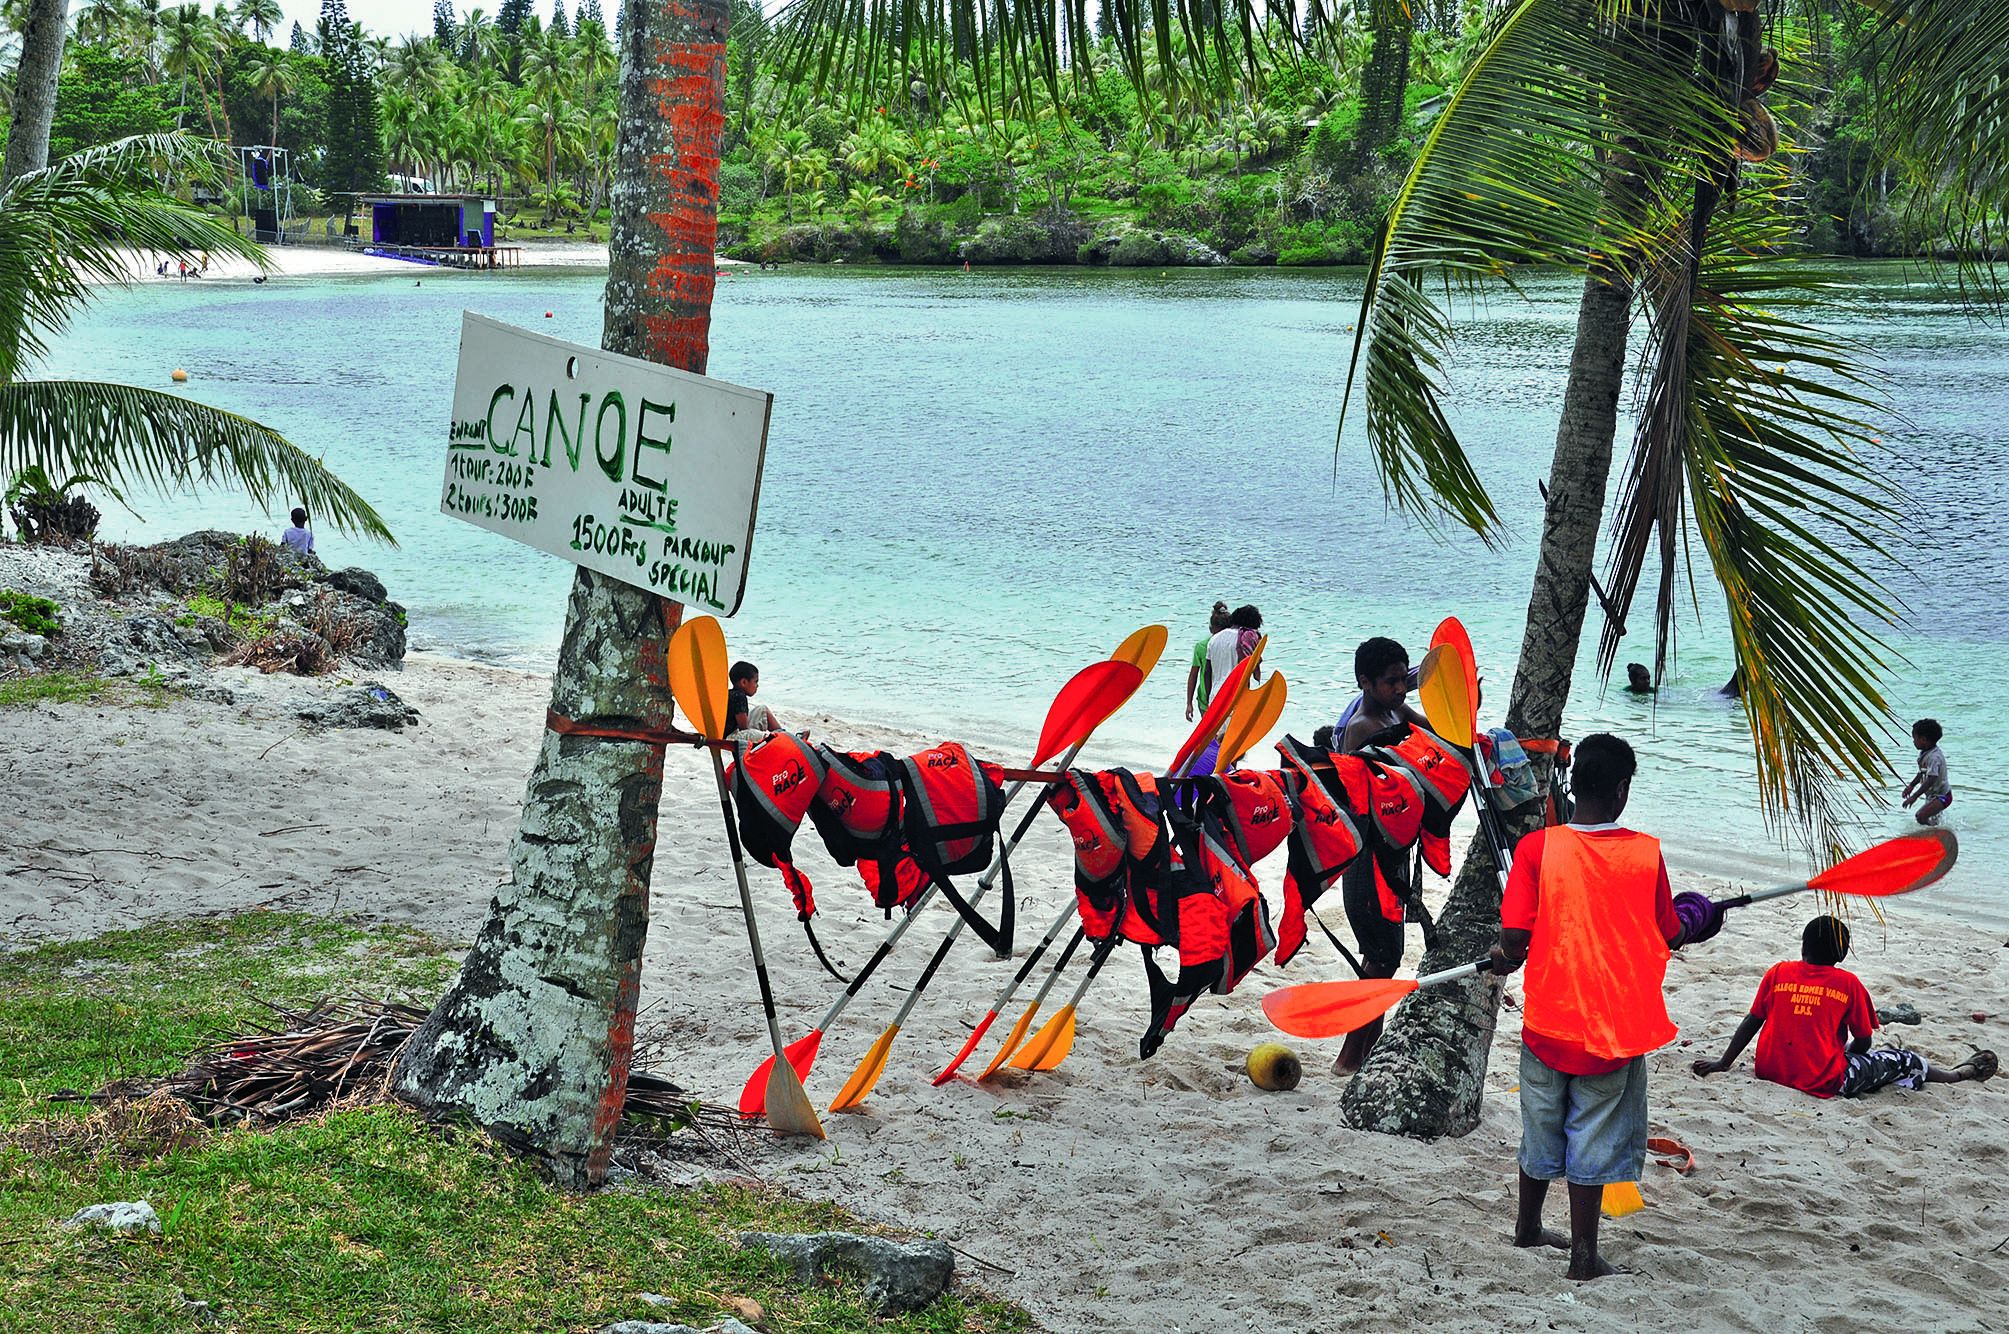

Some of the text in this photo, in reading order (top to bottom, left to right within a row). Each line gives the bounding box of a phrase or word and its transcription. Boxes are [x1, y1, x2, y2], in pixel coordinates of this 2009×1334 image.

[487, 383, 676, 494] CANOE
[618, 488, 679, 526] ADULTE
[649, 561, 725, 610] SPECIAL
[928, 757, 958, 768] RACE
[775, 765, 805, 797] RACE
[1251, 807, 1279, 825] RACE
